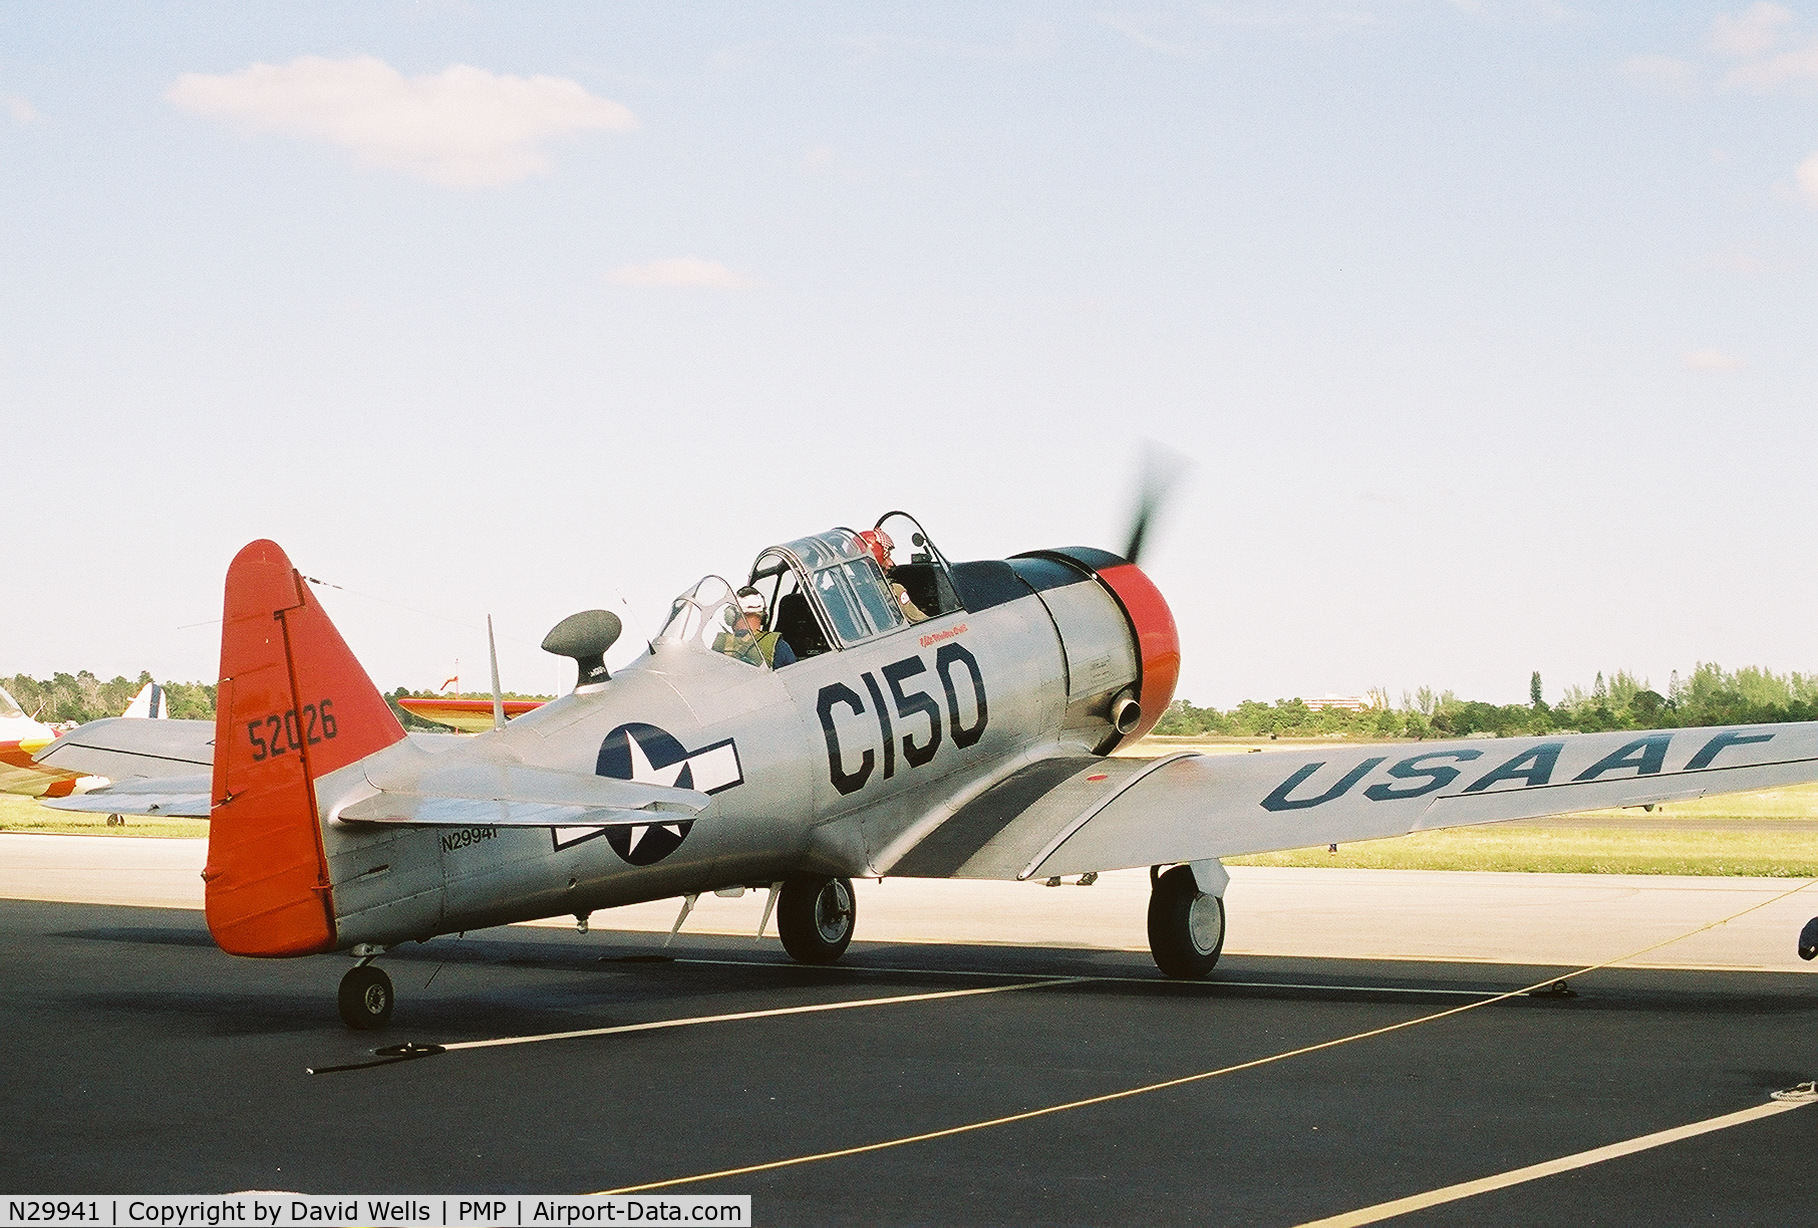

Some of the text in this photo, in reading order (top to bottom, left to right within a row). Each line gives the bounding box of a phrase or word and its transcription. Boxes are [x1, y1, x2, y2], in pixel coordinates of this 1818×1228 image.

[247, 698, 338, 762] 52026
[816, 641, 989, 797] C150
[1259, 727, 1776, 813] USAAF
[441, 827, 498, 854] N29941
